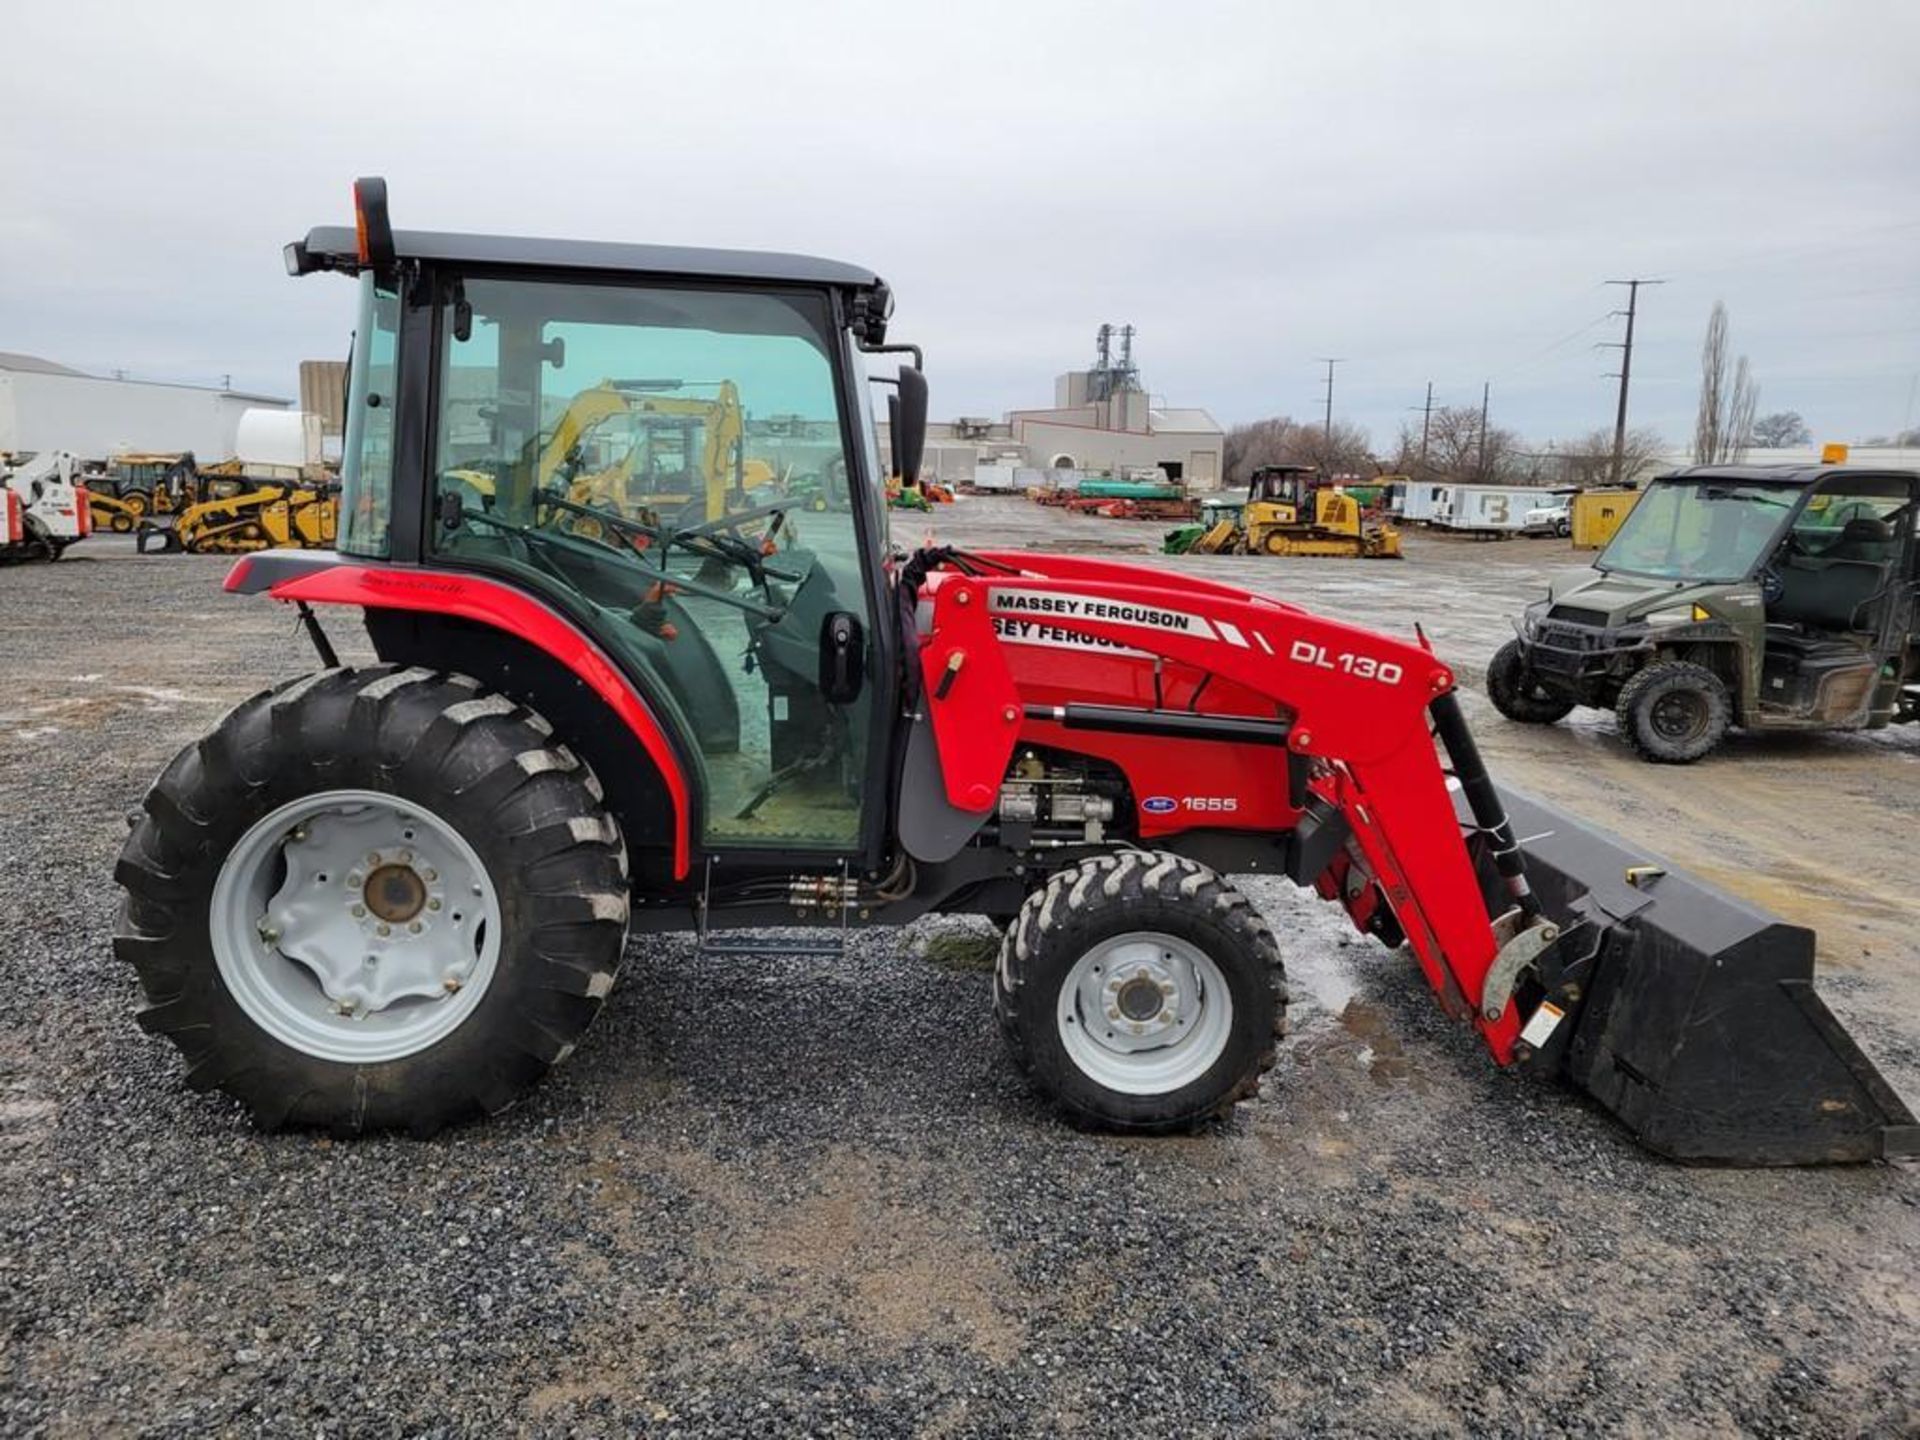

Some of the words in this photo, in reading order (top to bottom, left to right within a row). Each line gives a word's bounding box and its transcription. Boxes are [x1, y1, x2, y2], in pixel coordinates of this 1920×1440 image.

[996, 595, 1079, 614] MASSEY
[1084, 602, 1189, 629] FERGUSON
[1182, 797, 1237, 812] 1655
